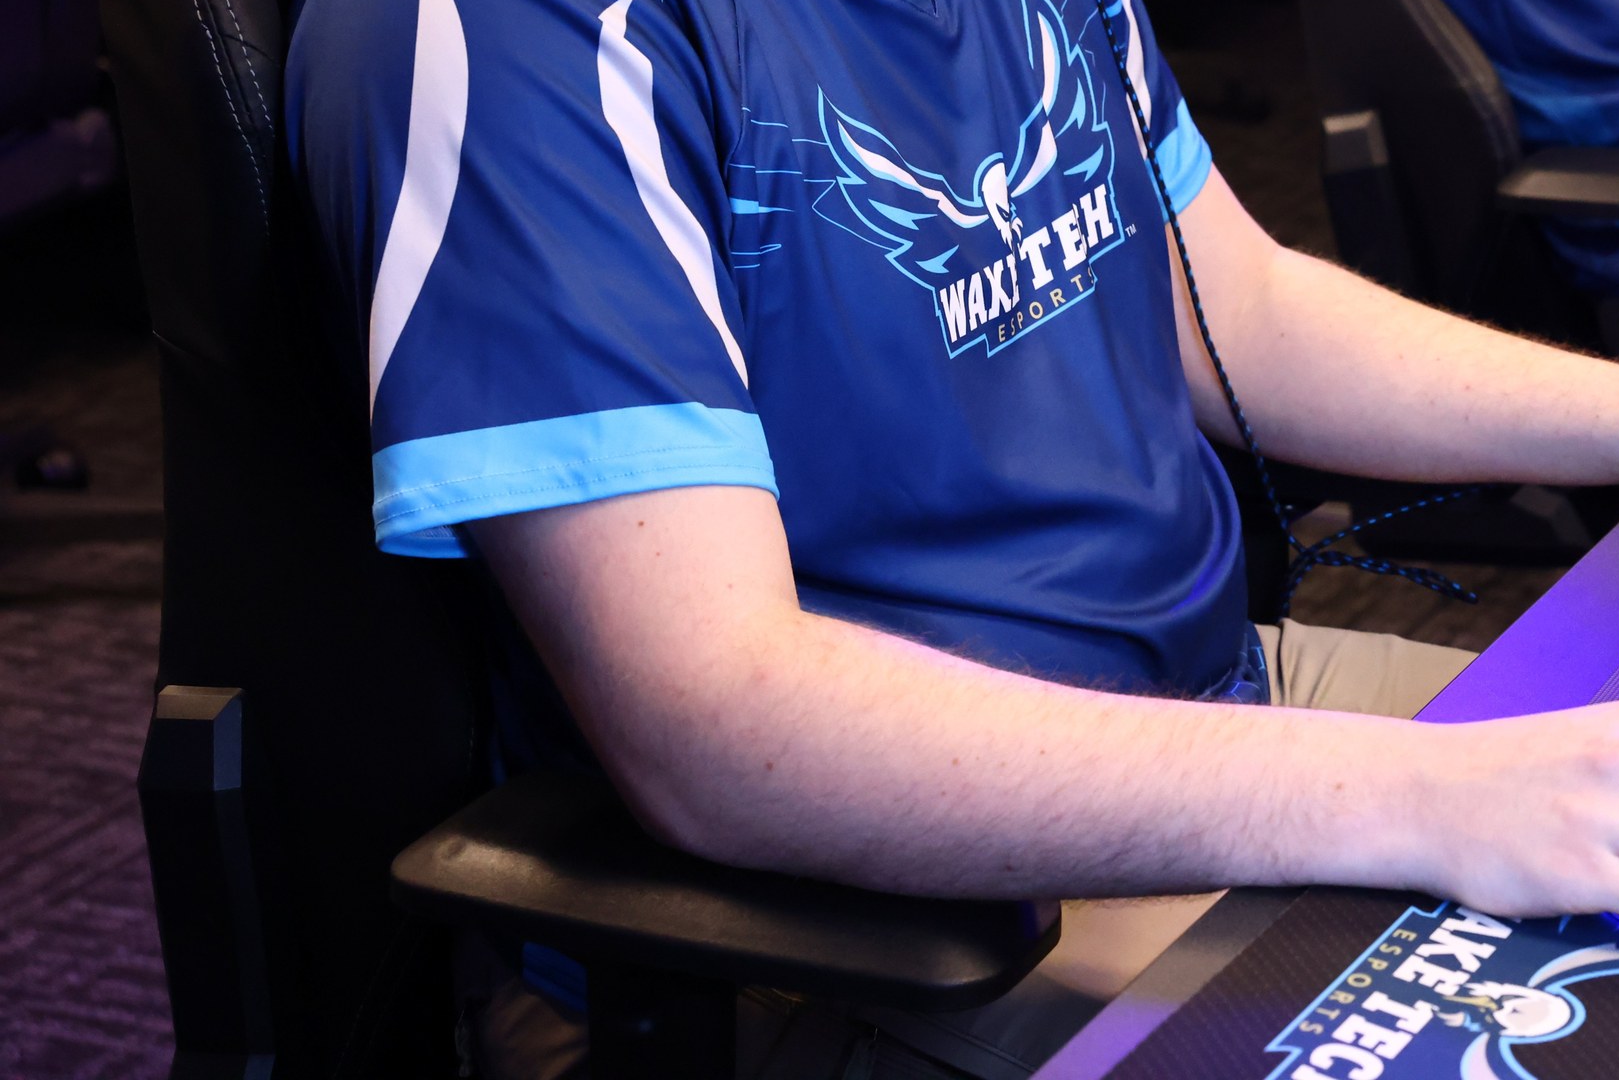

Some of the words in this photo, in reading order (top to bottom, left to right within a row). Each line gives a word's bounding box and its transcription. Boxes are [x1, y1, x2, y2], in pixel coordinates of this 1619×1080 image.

[1125, 223, 1137, 238] TM
[1299, 928, 1418, 1035] ESPORTS
[1392, 906, 1513, 997] AKE
